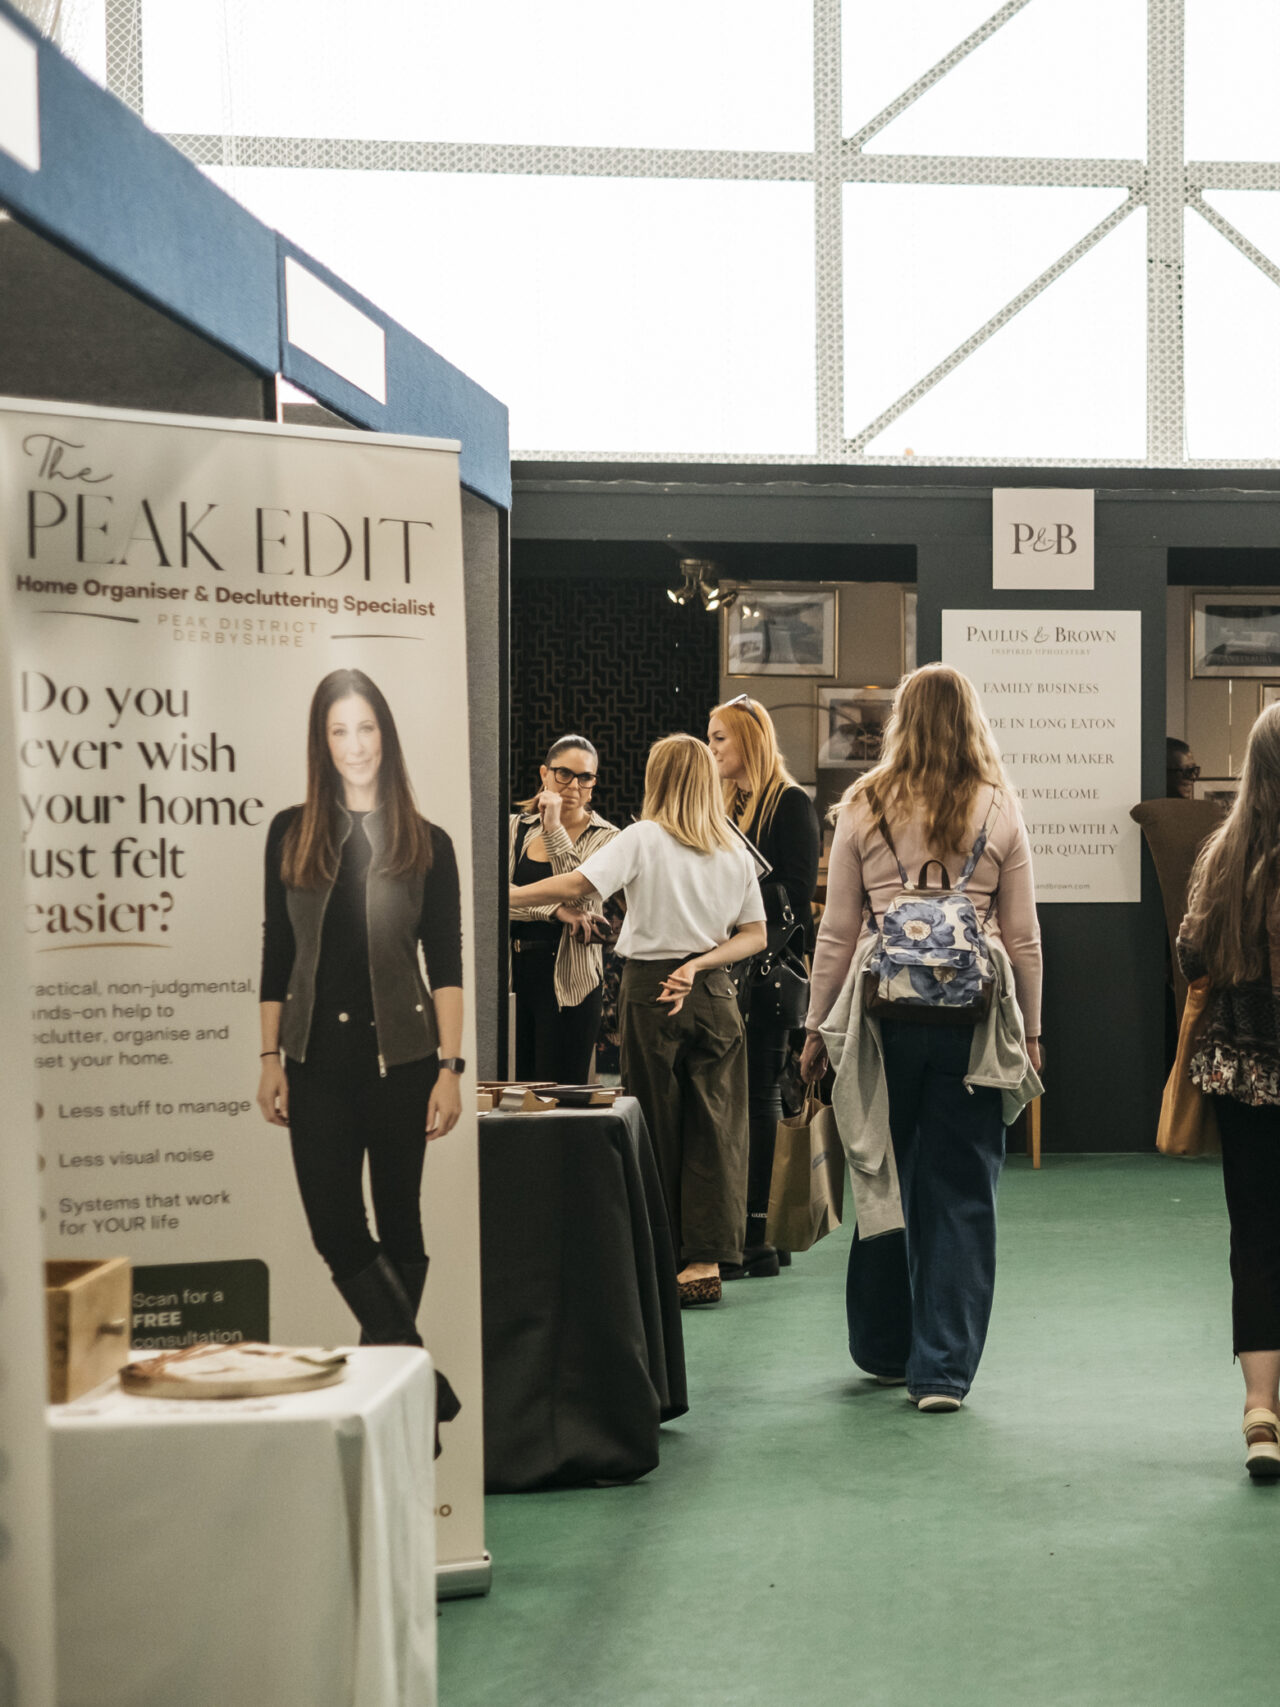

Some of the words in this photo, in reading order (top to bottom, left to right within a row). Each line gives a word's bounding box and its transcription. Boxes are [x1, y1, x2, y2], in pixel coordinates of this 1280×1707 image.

[22, 433, 113, 484] The
[27, 490, 225, 571] PEAK
[256, 507, 435, 584] EDIT
[1010, 523, 1077, 555] P&B
[16, 575, 78, 595] Home
[84, 579, 190, 605] Organiser
[194, 585, 209, 602] &
[215, 587, 339, 615] Decluttering
[343, 596, 436, 617] Specialist
[157, 613, 209, 630] PEAK
[219, 616, 319, 634] DISTRICT
[173, 629, 304, 648] DERBYSHIRE
[966, 626, 1029, 642] PAULUS
[1034, 626, 1050, 643] &
[1055, 627, 1117, 642] BROWN
[983, 683, 1032, 694] FAMILY
[1037, 683, 1100, 694] BUSINESS
[21, 671, 90, 715] Do
[106, 686, 189, 728] you
[989, 718, 1006, 729] DE
[1010, 718, 1025, 729] IN
[1029, 718, 1067, 729] LONG
[1071, 718, 1116, 729] EATON
[19, 737, 123, 771] ever
[137, 732, 236, 772] wish
[1022, 753, 1062, 764] FROM
[1065, 753, 1115, 764] MAKER
[1032, 788, 1100, 799] WELCOME
[20, 793, 125, 837] your
[139, 783, 264, 826] home
[1025, 823, 1065, 835] AFTED
[1068, 823, 1105, 835] WITH
[1110, 823, 1119, 835] A
[112, 837, 187, 879] felt
[1033, 844, 1053, 855] OR
[1056, 844, 1117, 857] QUALITY
[1035, 882, 1091, 890] andbrown.com
[25, 891, 174, 933] easier?
[32, 980, 102, 997] actical,
[107, 979, 257, 998] non-judgmental,
[32, 1005, 107, 1021] nds-on
[112, 1004, 151, 1021] help
[157, 1005, 174, 1018] to
[33, 1028, 109, 1046] clutter,
[113, 1027, 191, 1046] organise
[195, 1026, 230, 1041] and
[34, 1054, 64, 1069] set
[70, 1054, 114, 1071] your
[118, 1052, 174, 1067] home.
[58, 1101, 104, 1119] Less
[110, 1099, 151, 1118] stuff
[155, 1101, 173, 1117] to
[178, 1099, 251, 1118] manage
[58, 1151, 104, 1169] Less
[109, 1148, 160, 1166] visual
[165, 1146, 215, 1164] noise
[58, 1195, 140, 1217] Systems
[145, 1192, 180, 1209] that
[185, 1190, 230, 1206] work
[59, 1218, 86, 1236] for
[93, 1215, 145, 1235] YOUR
[150, 1213, 180, 1231] life
[133, 1292, 179, 1308] Scan
[182, 1288, 208, 1305] for
[212, 1290, 224, 1303] a
[133, 1311, 182, 1328] FREE
[133, 1329, 243, 1350] consultation
